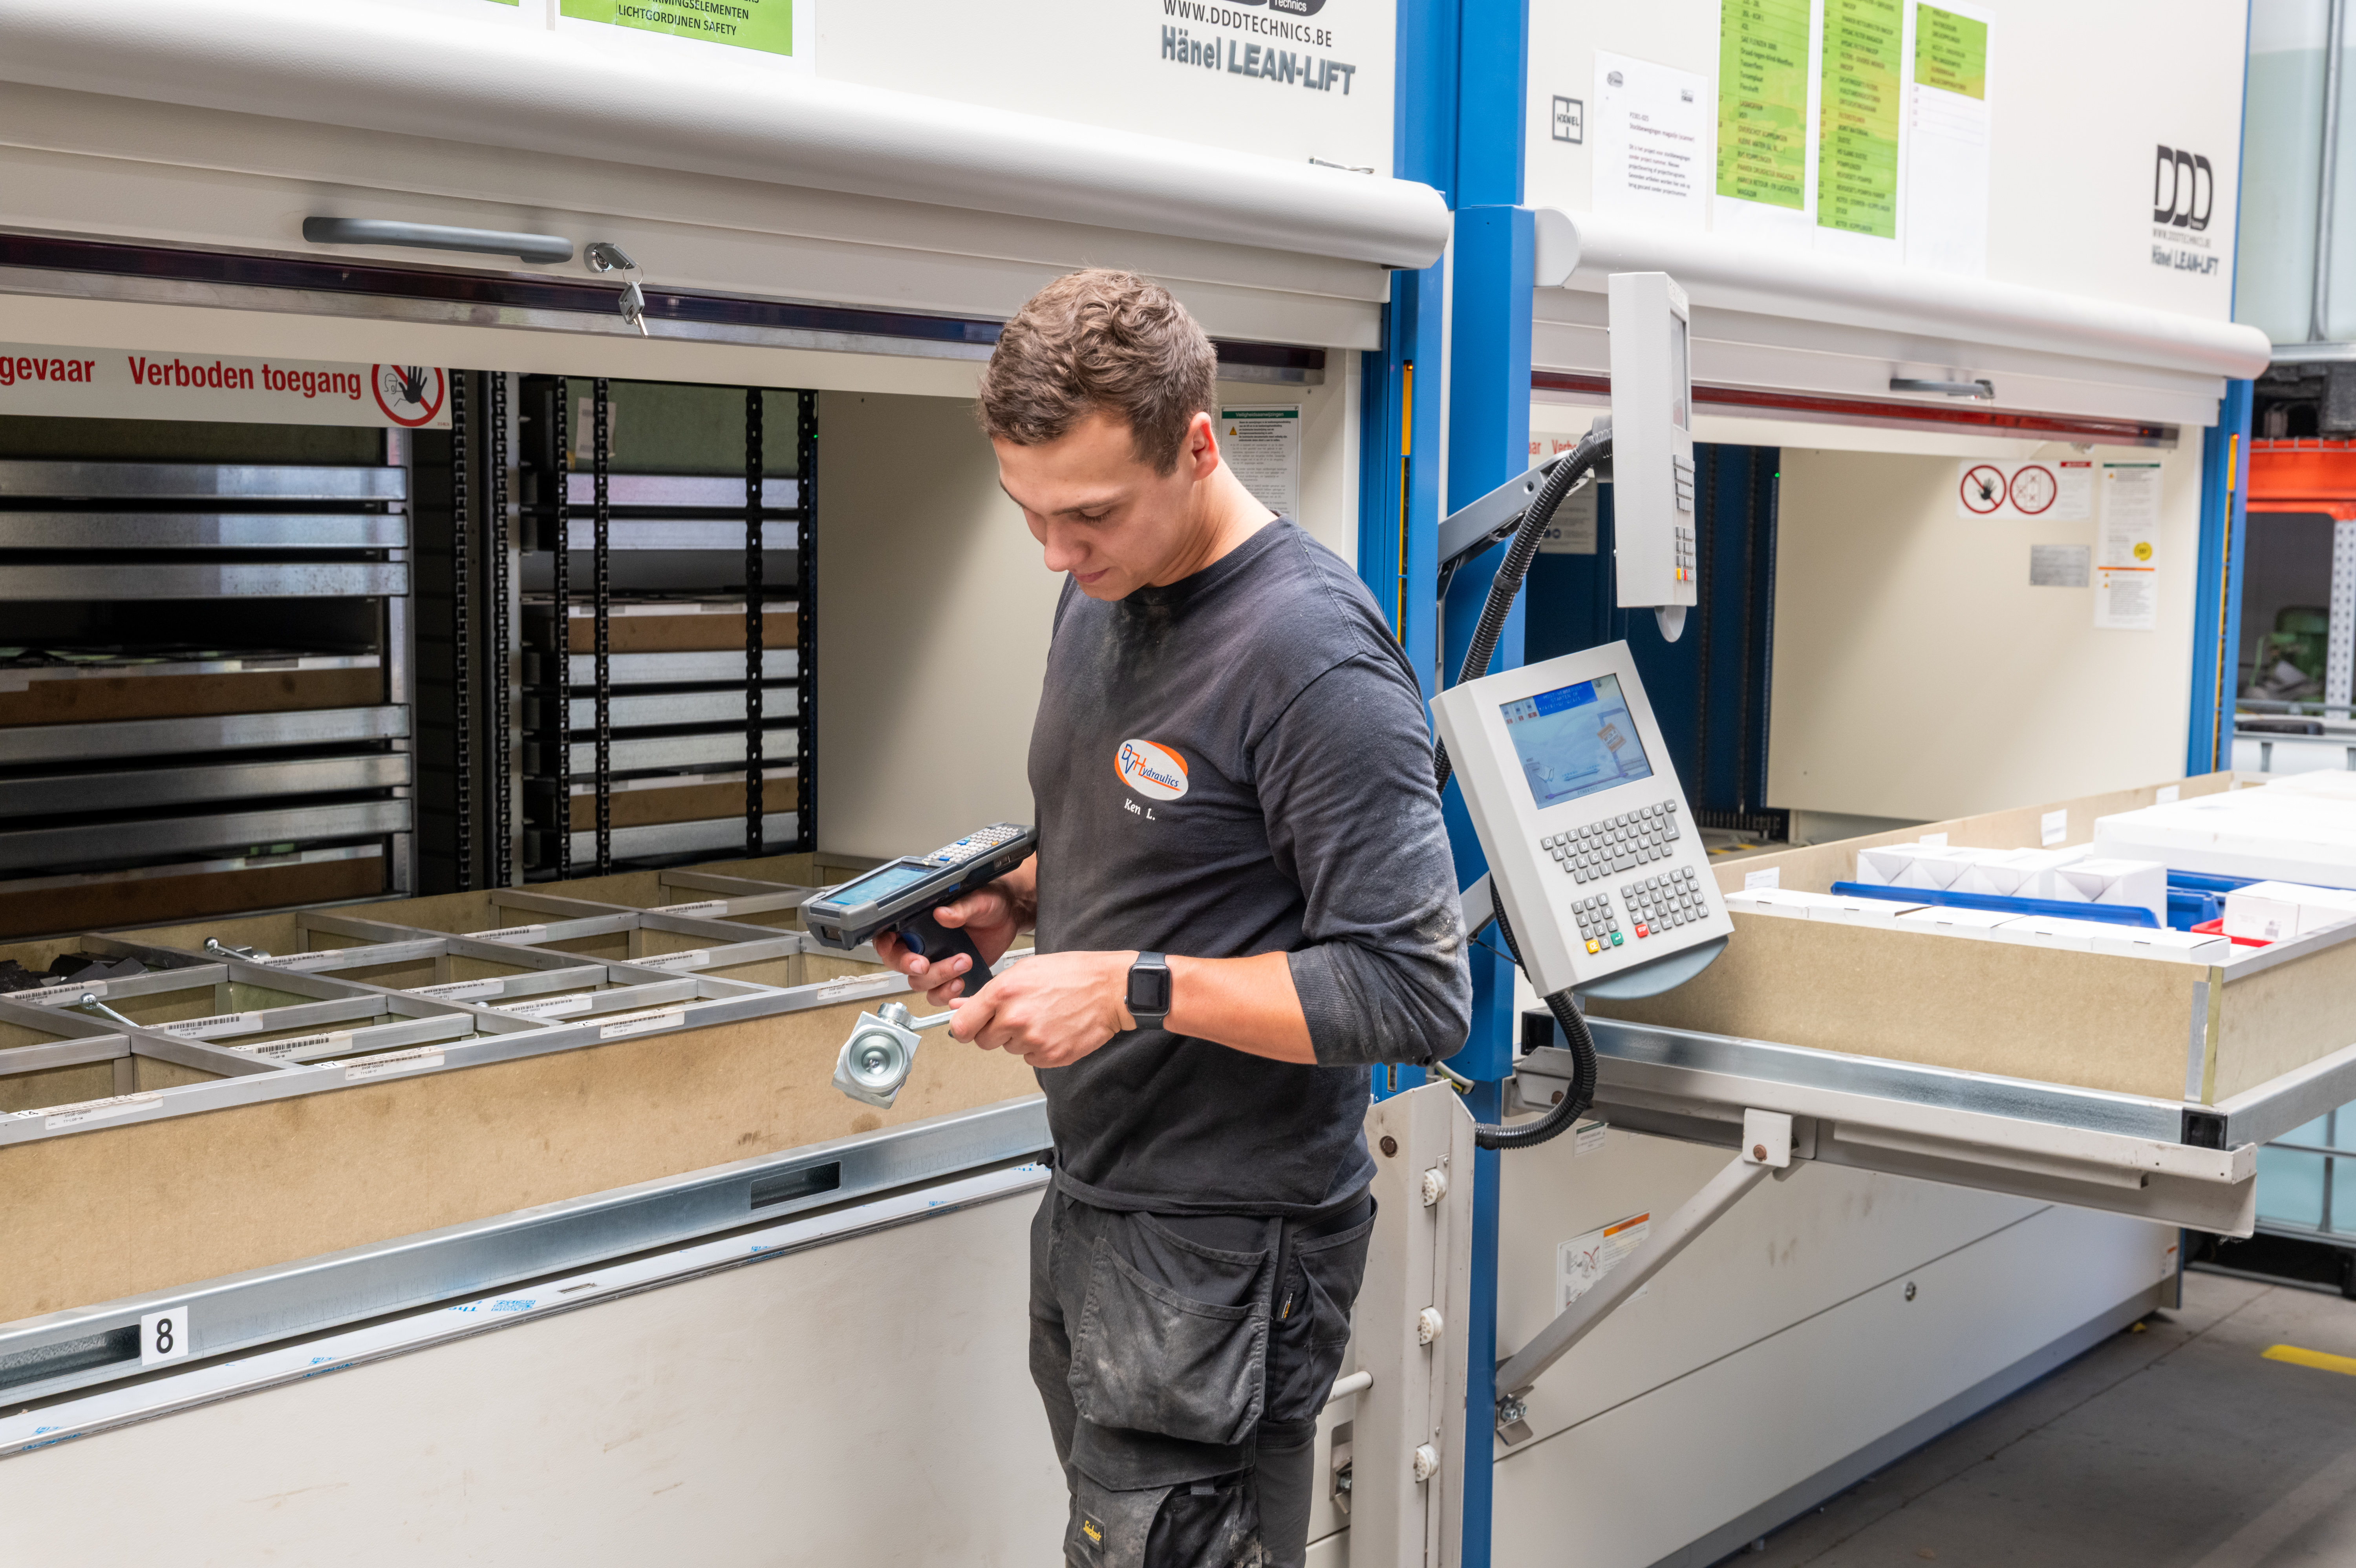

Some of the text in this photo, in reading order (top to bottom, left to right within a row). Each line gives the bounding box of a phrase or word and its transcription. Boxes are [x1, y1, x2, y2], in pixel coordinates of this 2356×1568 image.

[618, 4, 737, 35] LICHTGORDIJNEN SAFETY
[1163, 0, 1332, 48] WWW.DDDTECHNICS.BE
[1161, 24, 1356, 95] Hänel LEAN-LIFT
[2154, 144, 2213, 231] DDD
[128, 356, 254, 389] Verboden
[262, 364, 361, 400] toegang
[1124, 798, 1156, 821] Ken L.
[1590, 942, 1598, 950] CE
[1284, 1293, 1293, 1319] CORDURA
[156, 1318, 174, 1354] 8
